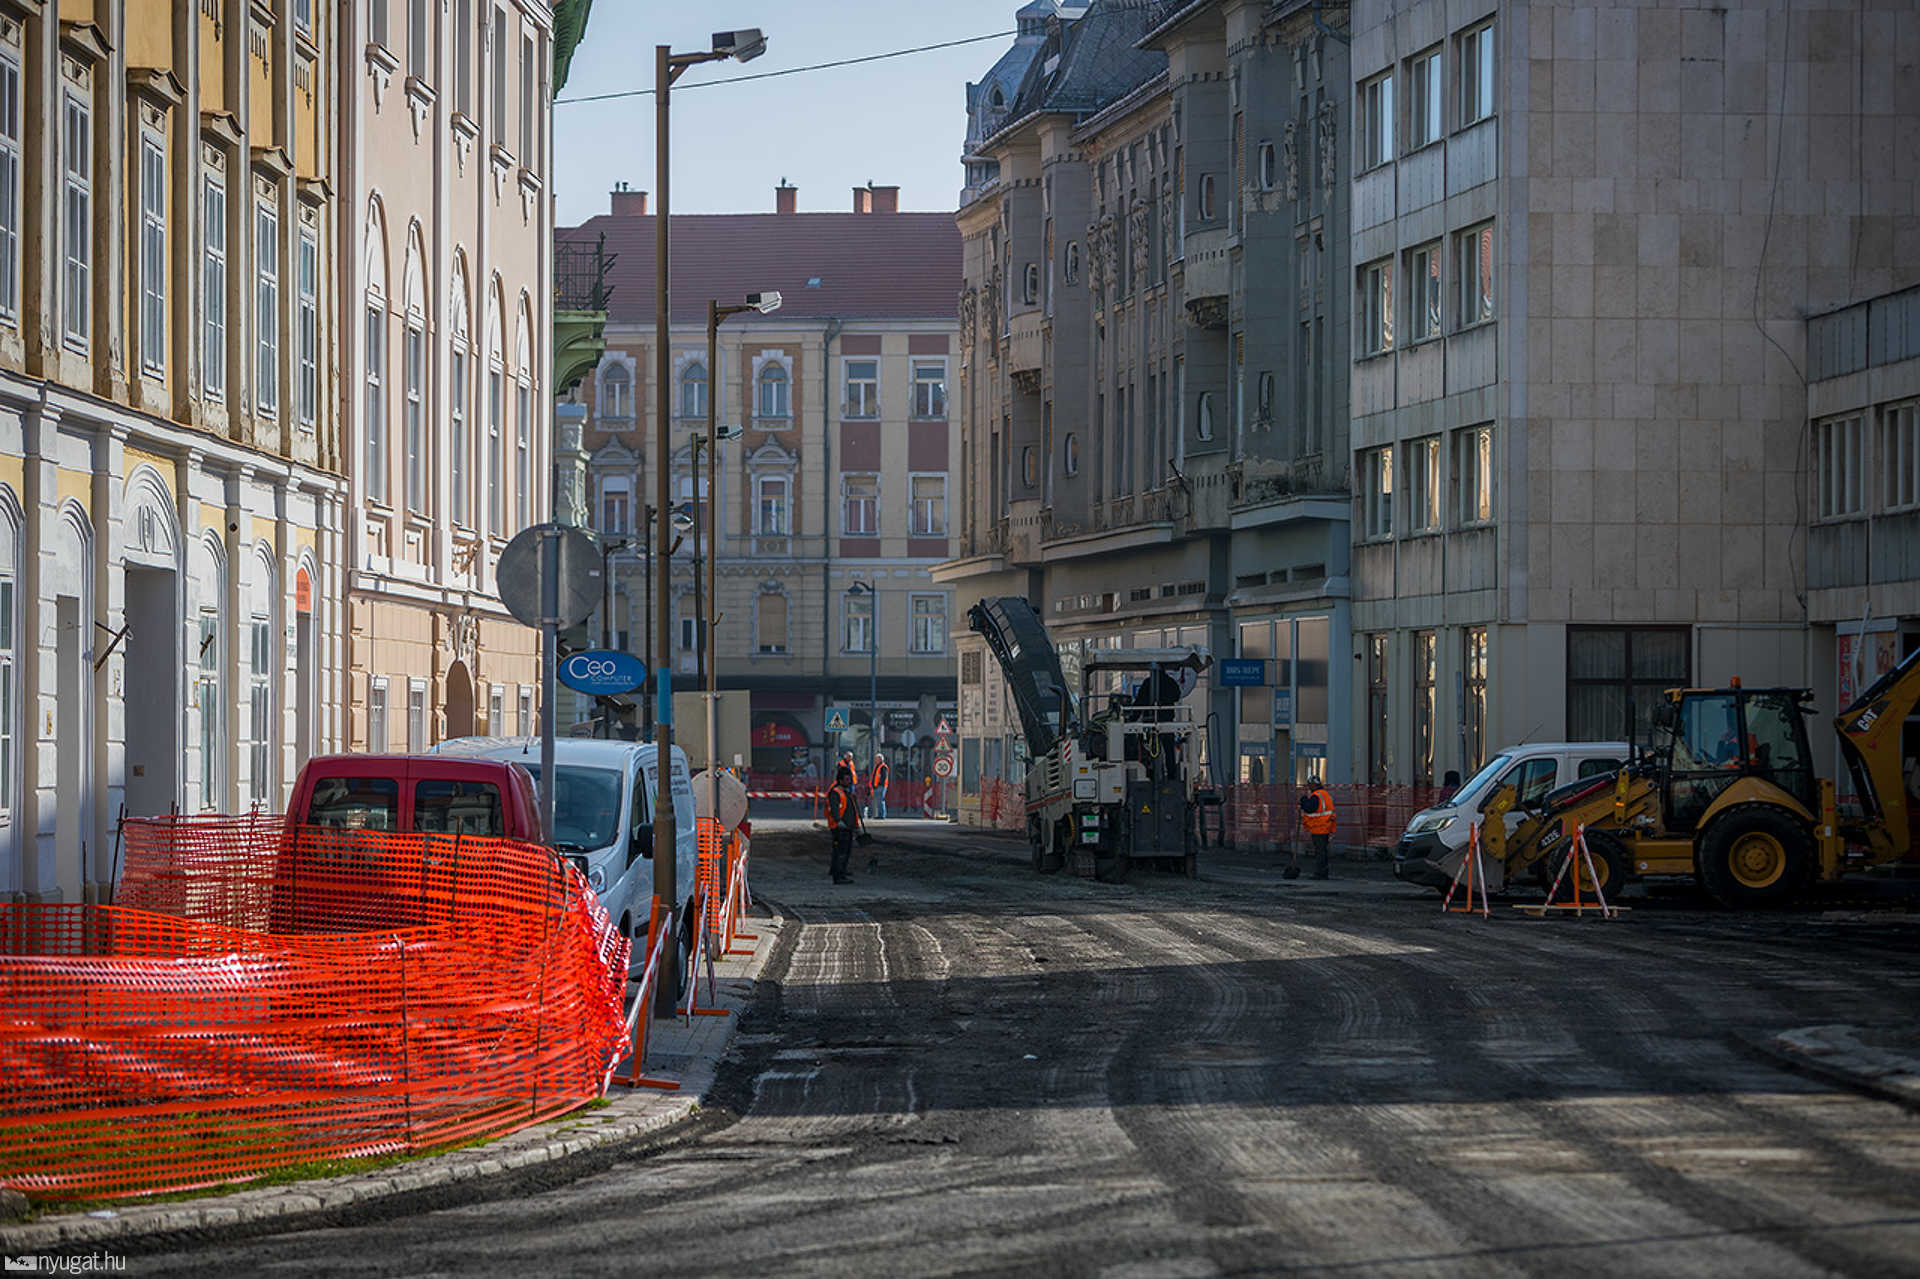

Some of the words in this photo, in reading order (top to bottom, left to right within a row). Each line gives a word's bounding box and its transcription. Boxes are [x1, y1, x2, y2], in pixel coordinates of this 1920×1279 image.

[569, 656, 616, 679] Ceo
[1857, 708, 1878, 731] CAT
[937, 762, 949, 771] 30
